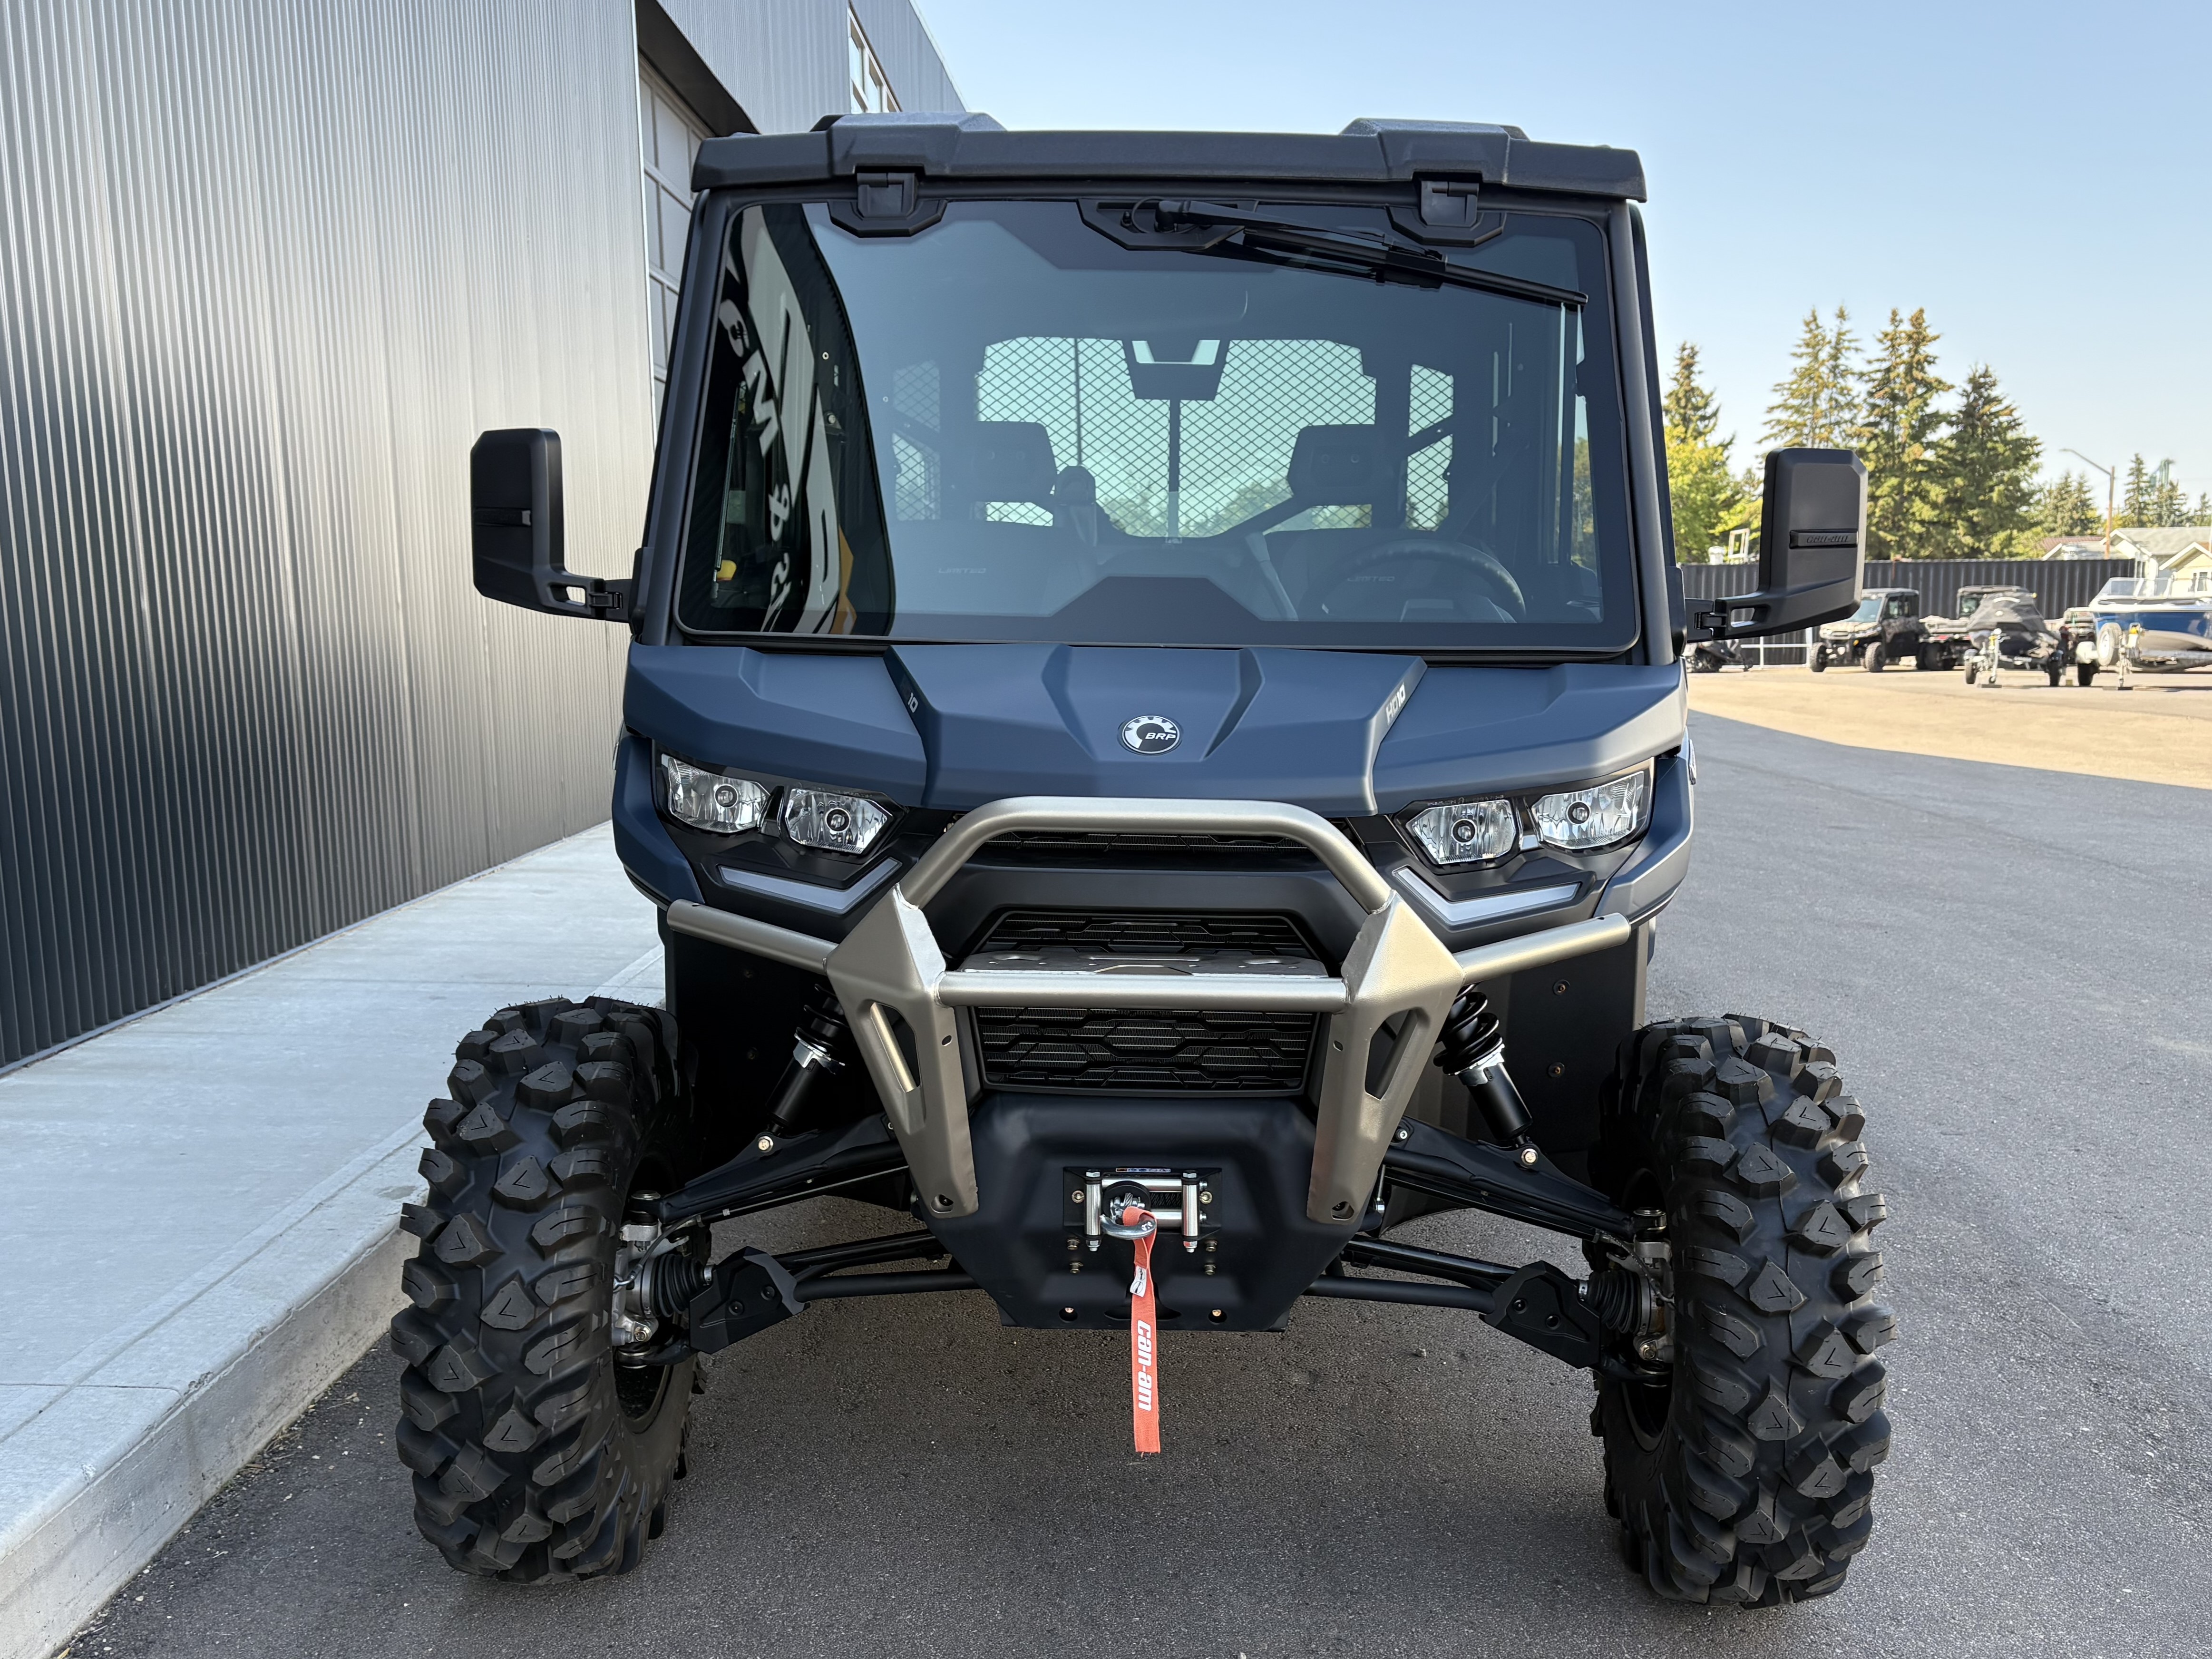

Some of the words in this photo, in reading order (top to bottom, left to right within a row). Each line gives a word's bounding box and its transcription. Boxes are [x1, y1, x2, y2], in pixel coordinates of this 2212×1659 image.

[1385, 682, 1406, 725] HD10
[1145, 732, 1176, 741] BRP
[1137, 1319, 1152, 1411] can-am
